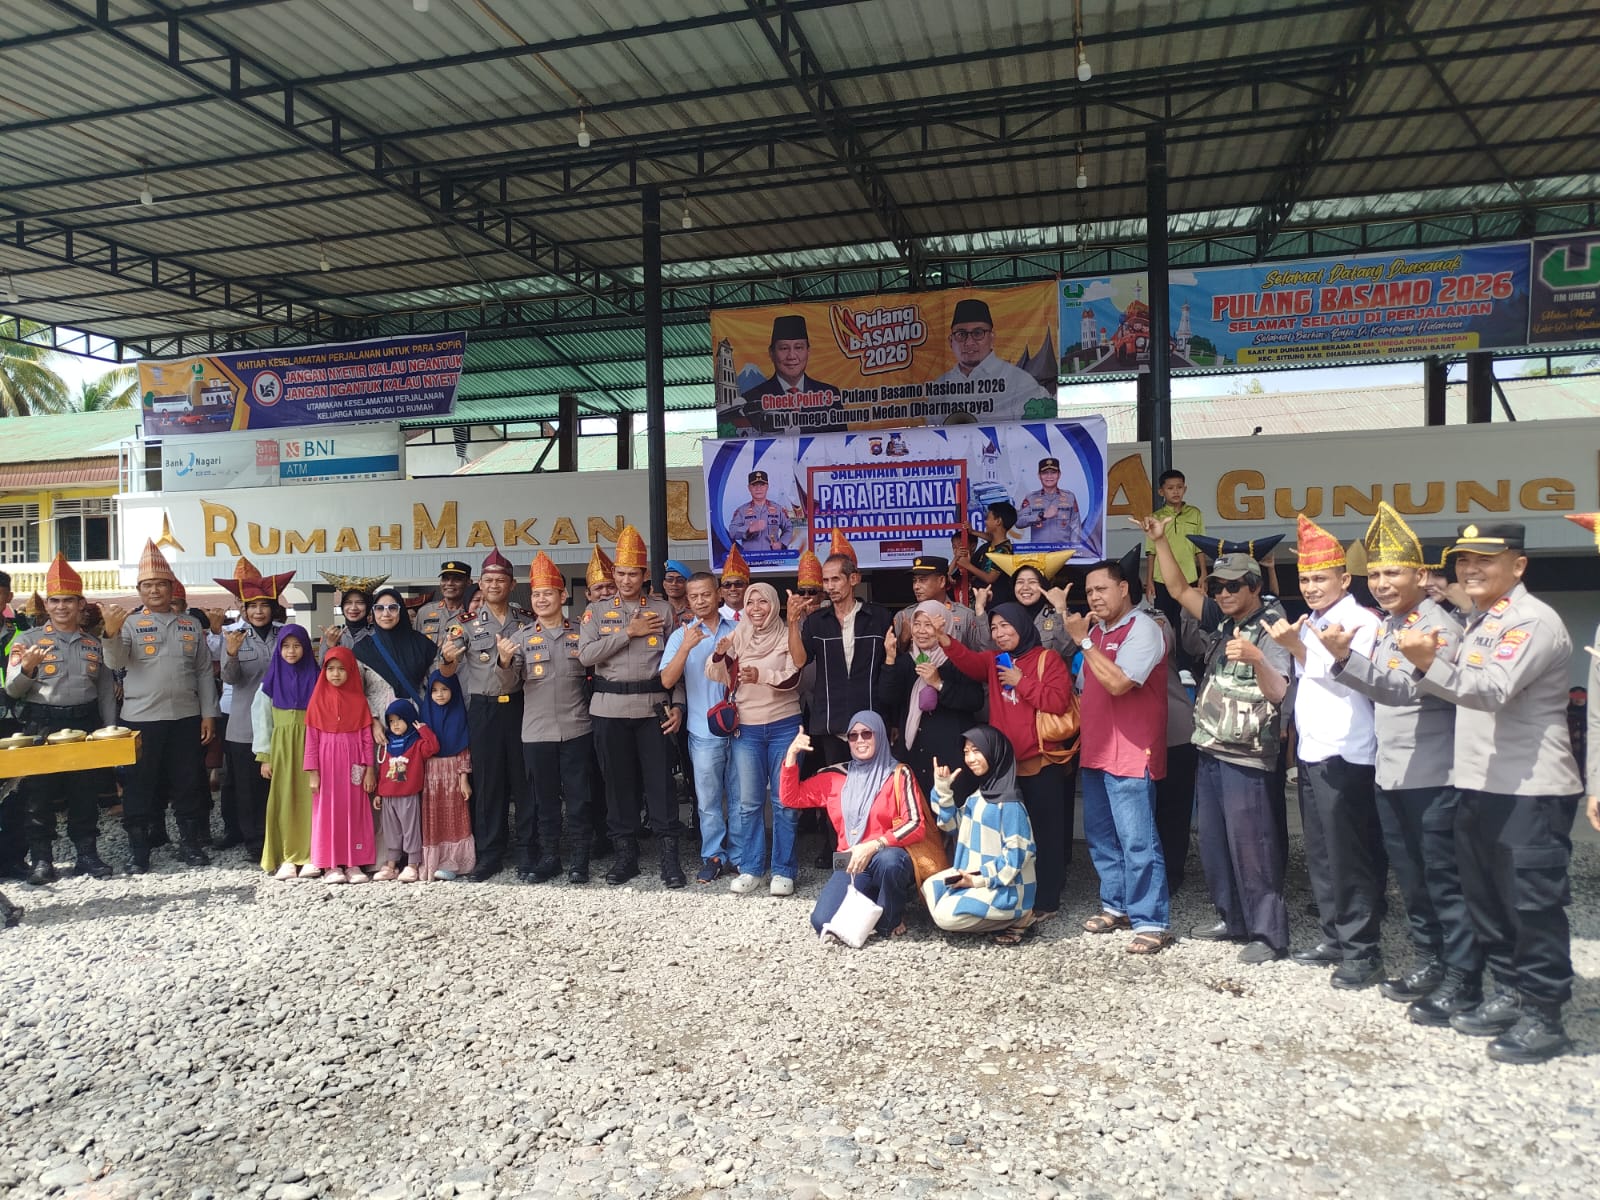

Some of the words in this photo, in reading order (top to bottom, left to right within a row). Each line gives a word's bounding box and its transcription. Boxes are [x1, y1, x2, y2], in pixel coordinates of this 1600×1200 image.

[1262, 269, 1325, 289] Selamat
[1327, 263, 1384, 284] Datang
[1386, 254, 1462, 280] Dunsanak
[1211, 288, 1313, 321] PULANG
[1319, 279, 1433, 314] BASAMO
[1437, 271, 1514, 305] 2026
[856, 308, 914, 329] Pulang
[1228, 318, 1298, 334] SELAMAT
[1301, 312, 1360, 328] SELALU
[1365, 310, 1381, 323] DI
[1386, 302, 1492, 322] PERJALANAN
[236, 360, 267, 370] IKHTIAR
[269, 354, 327, 368] KESELAMATAN
[329, 349, 381, 362] PERJALANAN
[383, 345, 410, 357] UNTUK
[412, 343, 434, 353] PARA
[436, 340, 462, 351] SOPIR
[283, 368, 327, 384] JANGAN
[328, 365, 367, 380] NYETIR
[368, 361, 407, 377] KALAU
[408, 355, 463, 373] NGANTUK
[865, 343, 908, 368] 2026
[284, 384, 328, 401] JANGAN
[329, 380, 381, 398] NGANTUK
[383, 375, 421, 392] KALAU
[306, 400, 343, 410] UTAMAKAN
[344, 395, 394, 408] KESELAMATAN
[395, 391, 445, 402] PERJALANAN
[762, 393, 794, 410] Check
[796, 391, 824, 409] Point
[825, 391, 833, 405] 3
[842, 388, 878, 404] Pulang
[880, 384, 923, 400] Basamo
[925, 381, 975, 397] Nasional
[977, 378, 1006, 394] 2026
[317, 409, 353, 420] KELUARGA
[354, 406, 395, 416] MENUNGGU
[397, 405, 405, 413] DI
[406, 403, 434, 413] RUMAH
[774, 412, 791, 427] RM
[792, 411, 828, 426] Umega
[829, 409, 869, 424] Gunung
[871, 405, 908, 420] Medan
[910, 398, 994, 418] (Dharmasraya)
[165, 459, 183, 467] Bank
[195, 456, 221, 467] Nagari
[304, 440, 335, 457] BNI
[286, 464, 308, 475] ATM
[819, 483, 870, 512] PARA
[872, 479, 969, 509] PERANTA
[1216, 469, 1576, 521] GUNUNG
[200, 498, 402, 557] RUMAH
[904, 510, 984, 538] MINAG
